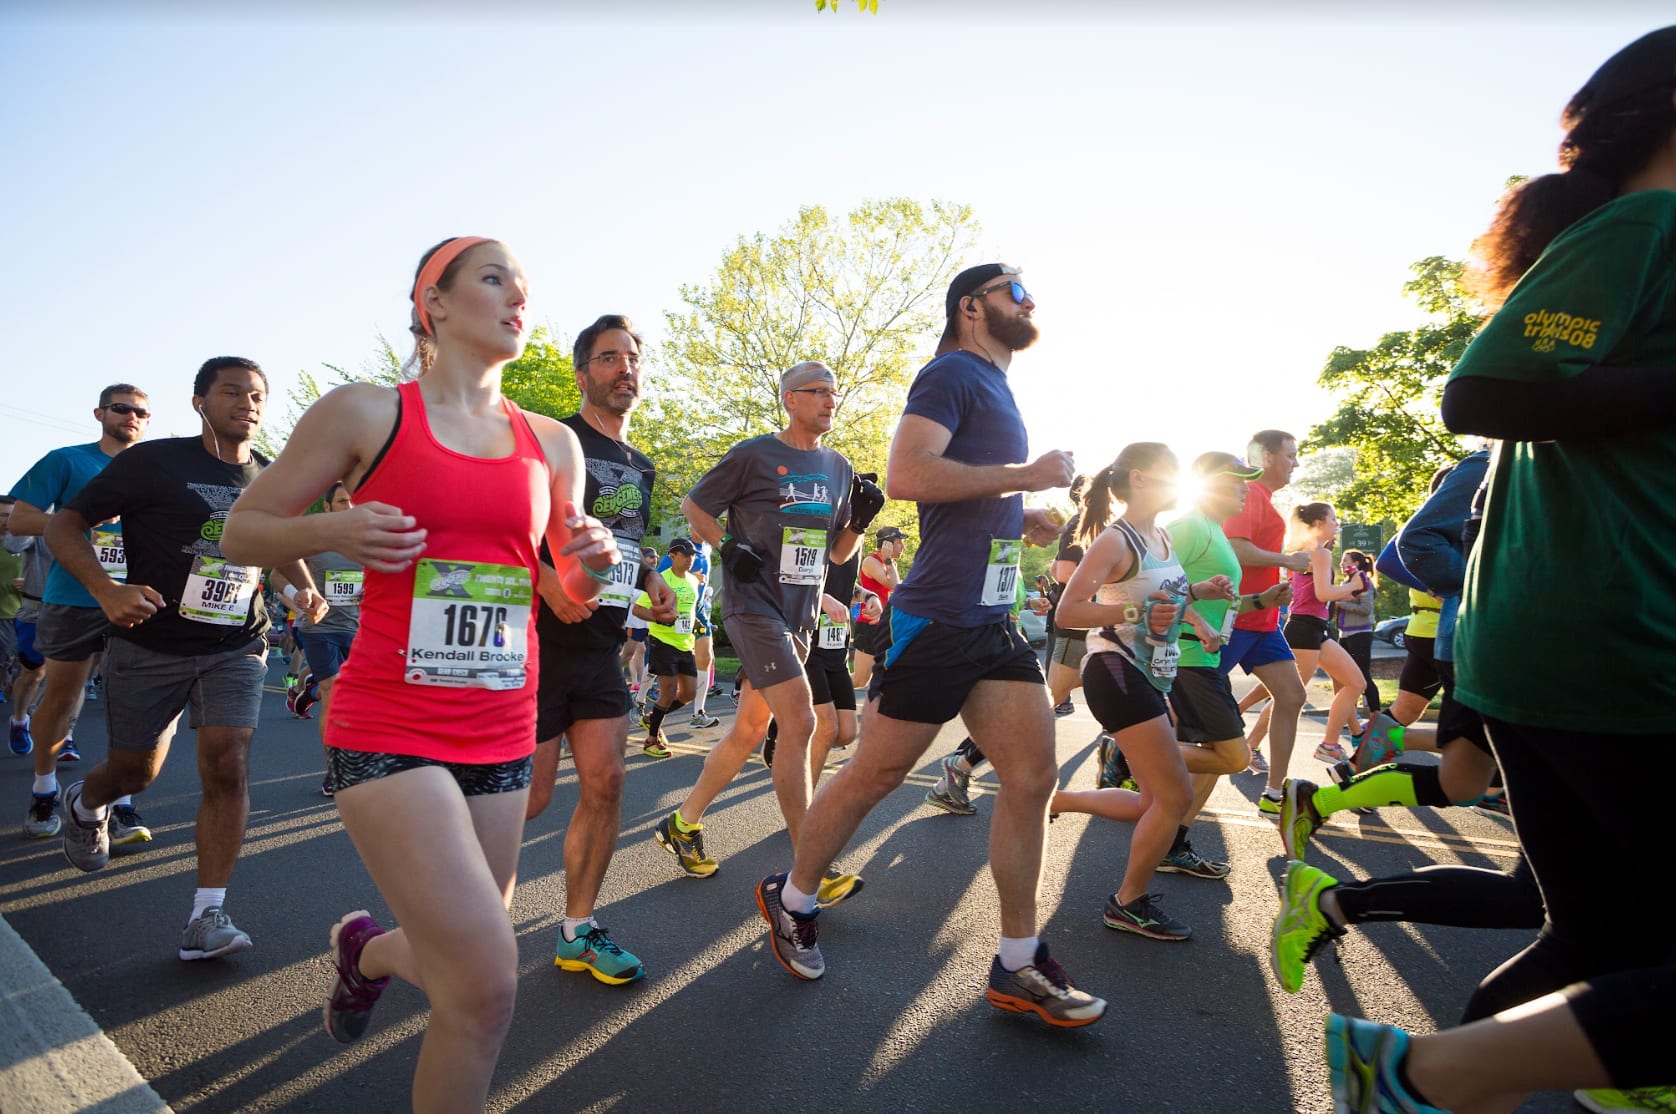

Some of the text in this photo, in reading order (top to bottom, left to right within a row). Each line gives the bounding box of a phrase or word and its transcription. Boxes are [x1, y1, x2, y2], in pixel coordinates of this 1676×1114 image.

[1524, 309, 1601, 335] olympic
[795, 547, 817, 567] 1519
[333, 582, 354, 595] 1599
[201, 601, 227, 611] MIKE
[443, 603, 508, 648] 1676
[411, 648, 475, 661] Kendall
